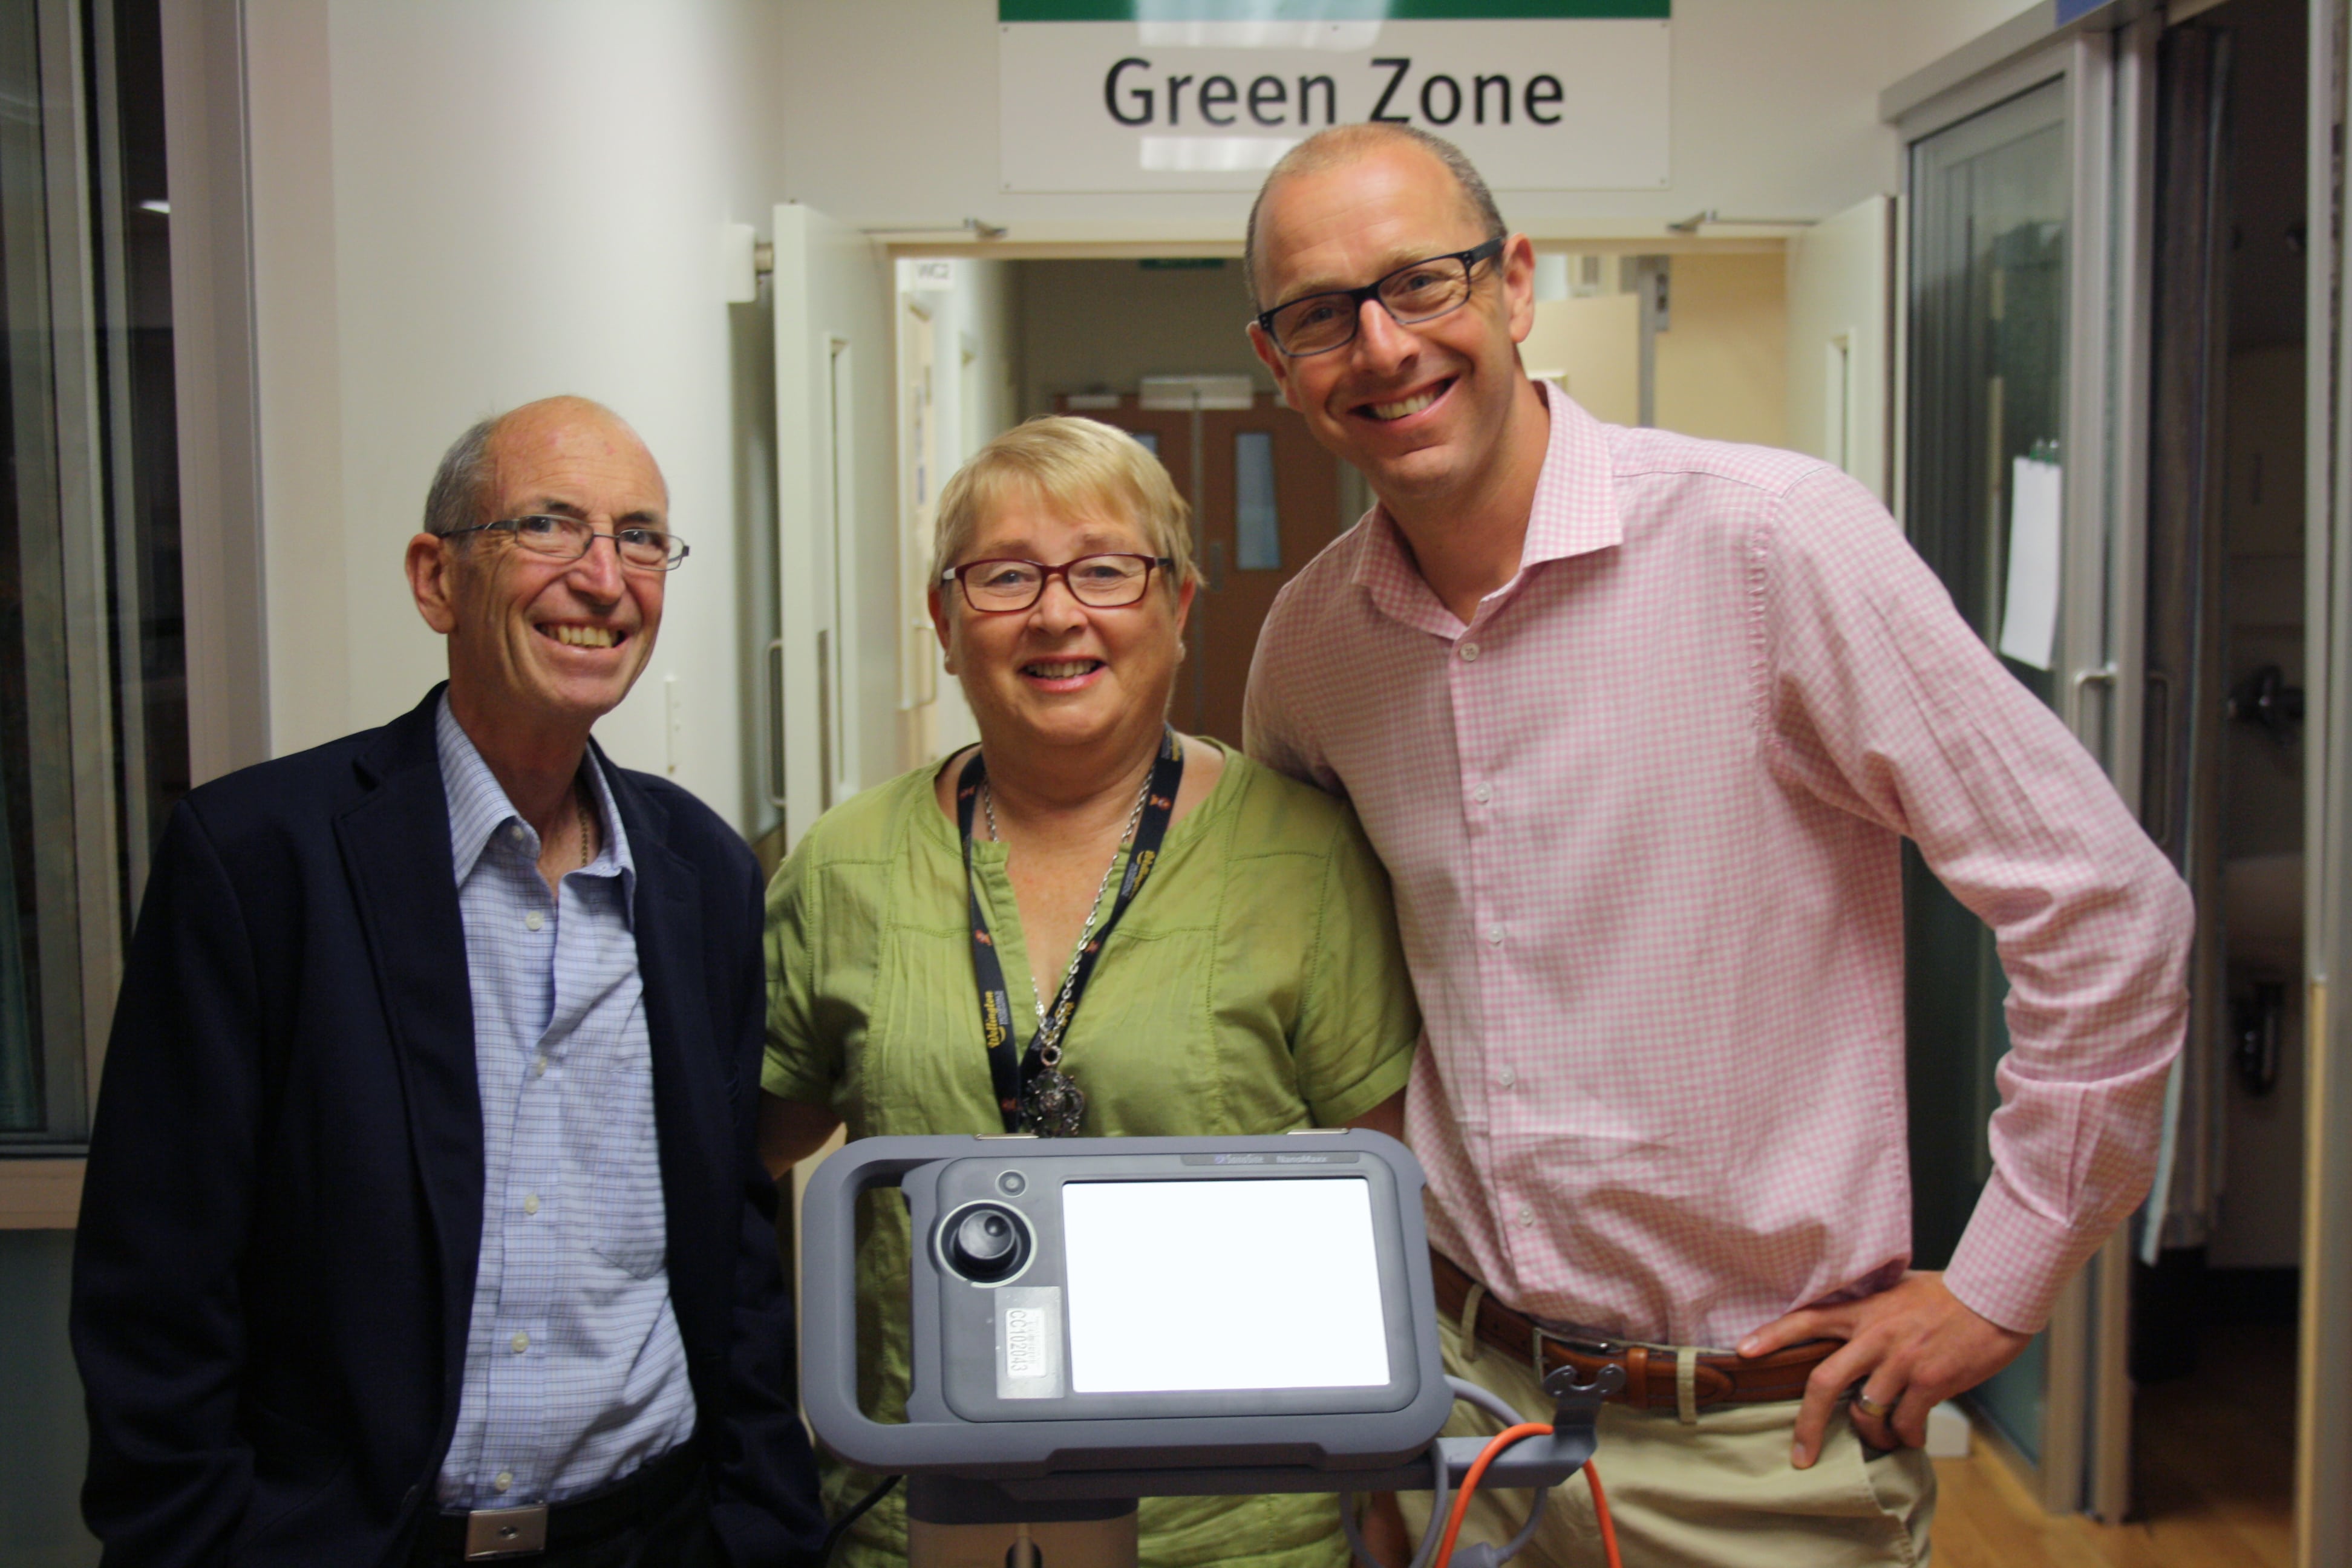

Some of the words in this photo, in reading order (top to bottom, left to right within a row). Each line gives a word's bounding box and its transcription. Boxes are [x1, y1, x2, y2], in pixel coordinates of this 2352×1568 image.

[1104, 57, 1336, 126] Green
[1368, 57, 1564, 125] Zone
[984, 990, 1002, 1048] Wellington
[1009, 1310, 1028, 1371] CC102043
